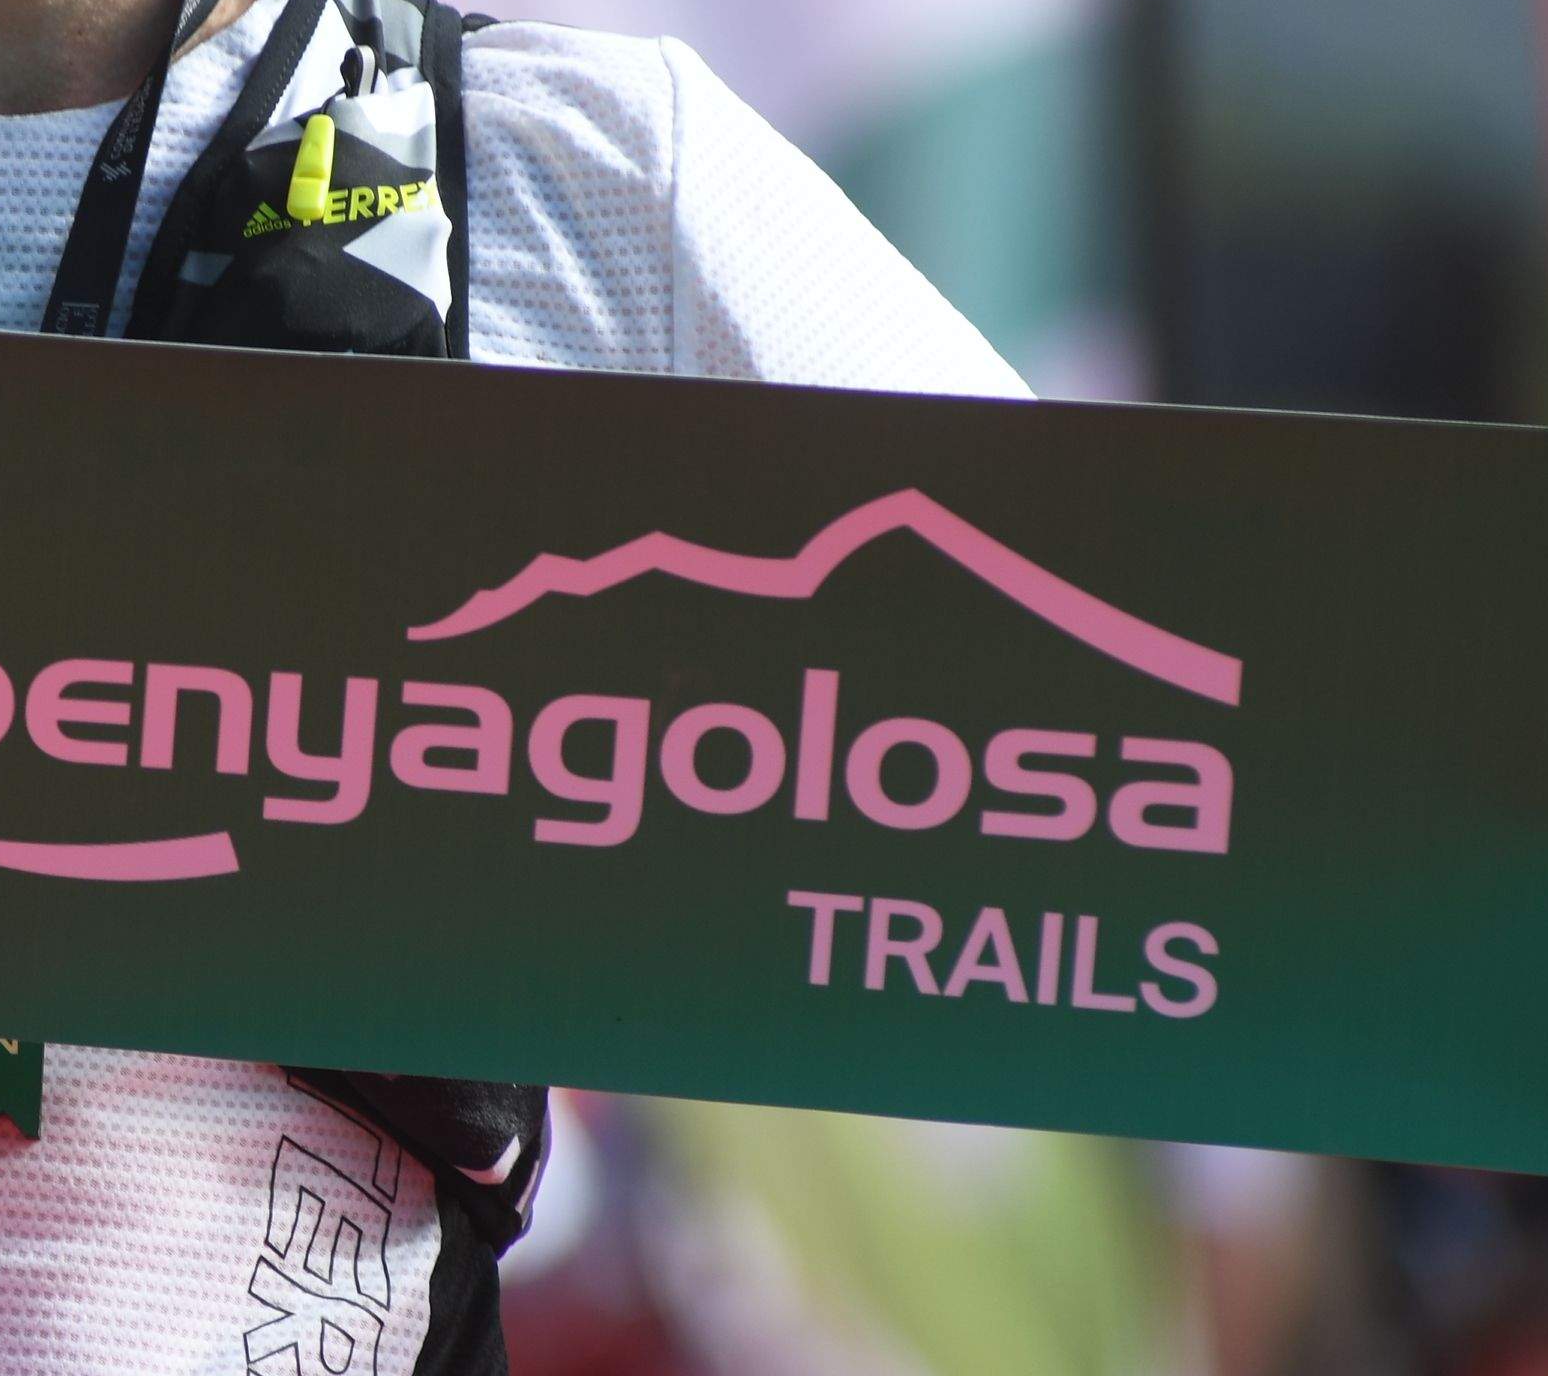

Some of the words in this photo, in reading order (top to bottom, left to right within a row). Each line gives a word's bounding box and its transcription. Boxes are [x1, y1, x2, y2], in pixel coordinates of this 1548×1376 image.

[304, 182, 438, 226] ERREX
[243, 218, 292, 239] adidas
[787, 889, 1221, 1019] TRAILS
